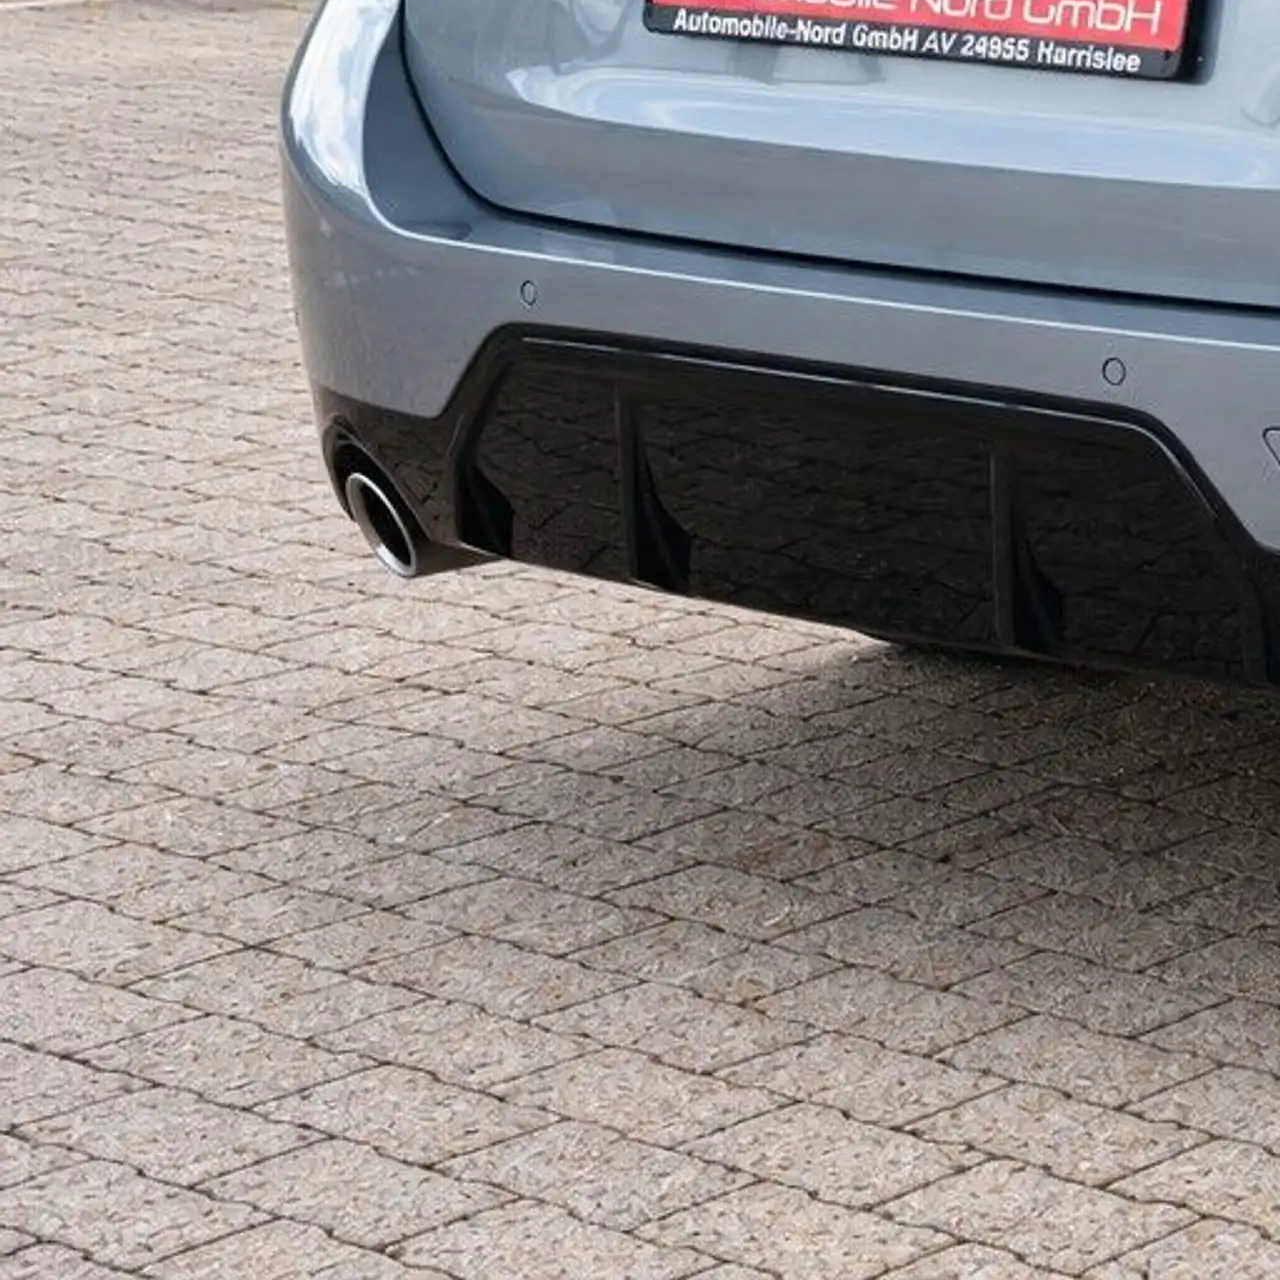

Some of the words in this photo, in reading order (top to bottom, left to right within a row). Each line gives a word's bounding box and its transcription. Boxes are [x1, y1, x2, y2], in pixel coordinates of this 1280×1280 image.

[673, 8, 848, 45] Automobile-Nord
[853, 24, 919, 52] GmbH
[921, 30, 958, 55] AV
[960, 34, 1031, 61] 24955
[1036, 40, 1142, 72] Harrislee
